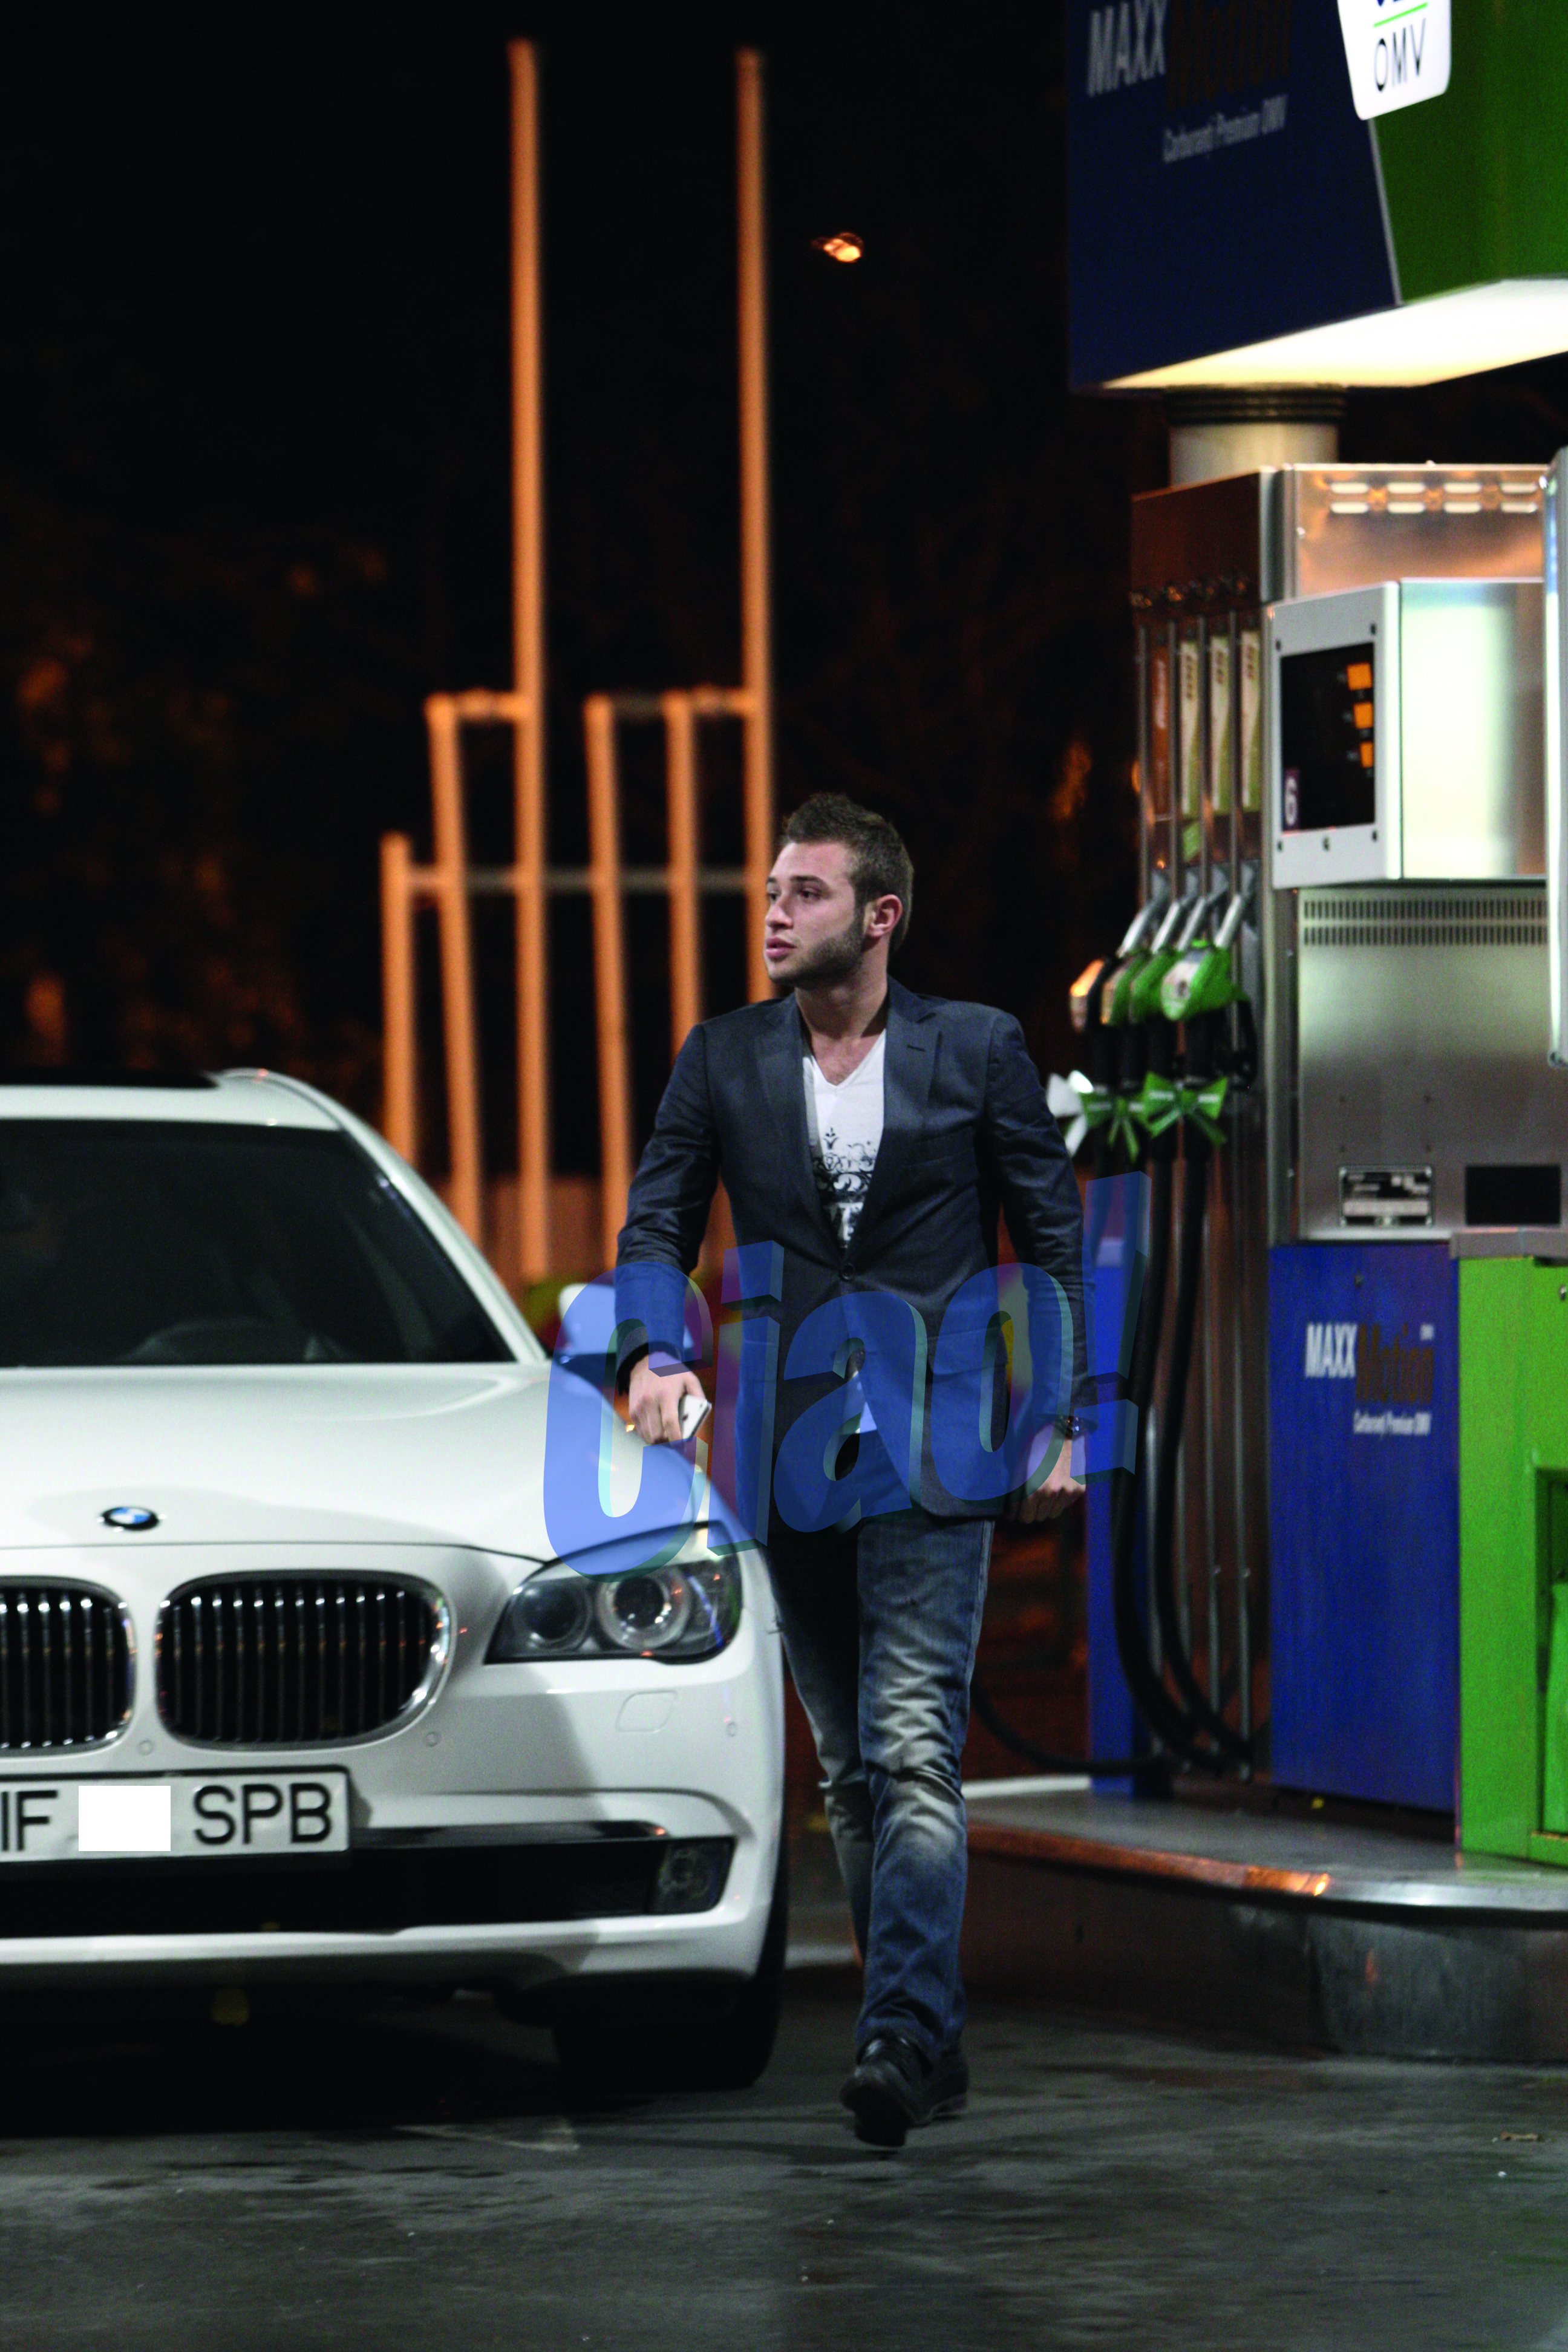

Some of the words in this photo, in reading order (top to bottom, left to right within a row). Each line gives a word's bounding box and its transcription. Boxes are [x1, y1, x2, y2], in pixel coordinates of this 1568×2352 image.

[1086, 0, 1168, 98] MAXX
[1374, 18, 1426, 93] OMV
[1305, 1322, 1357, 1379] MAXX
[192, 1782, 333, 1846] SPB
